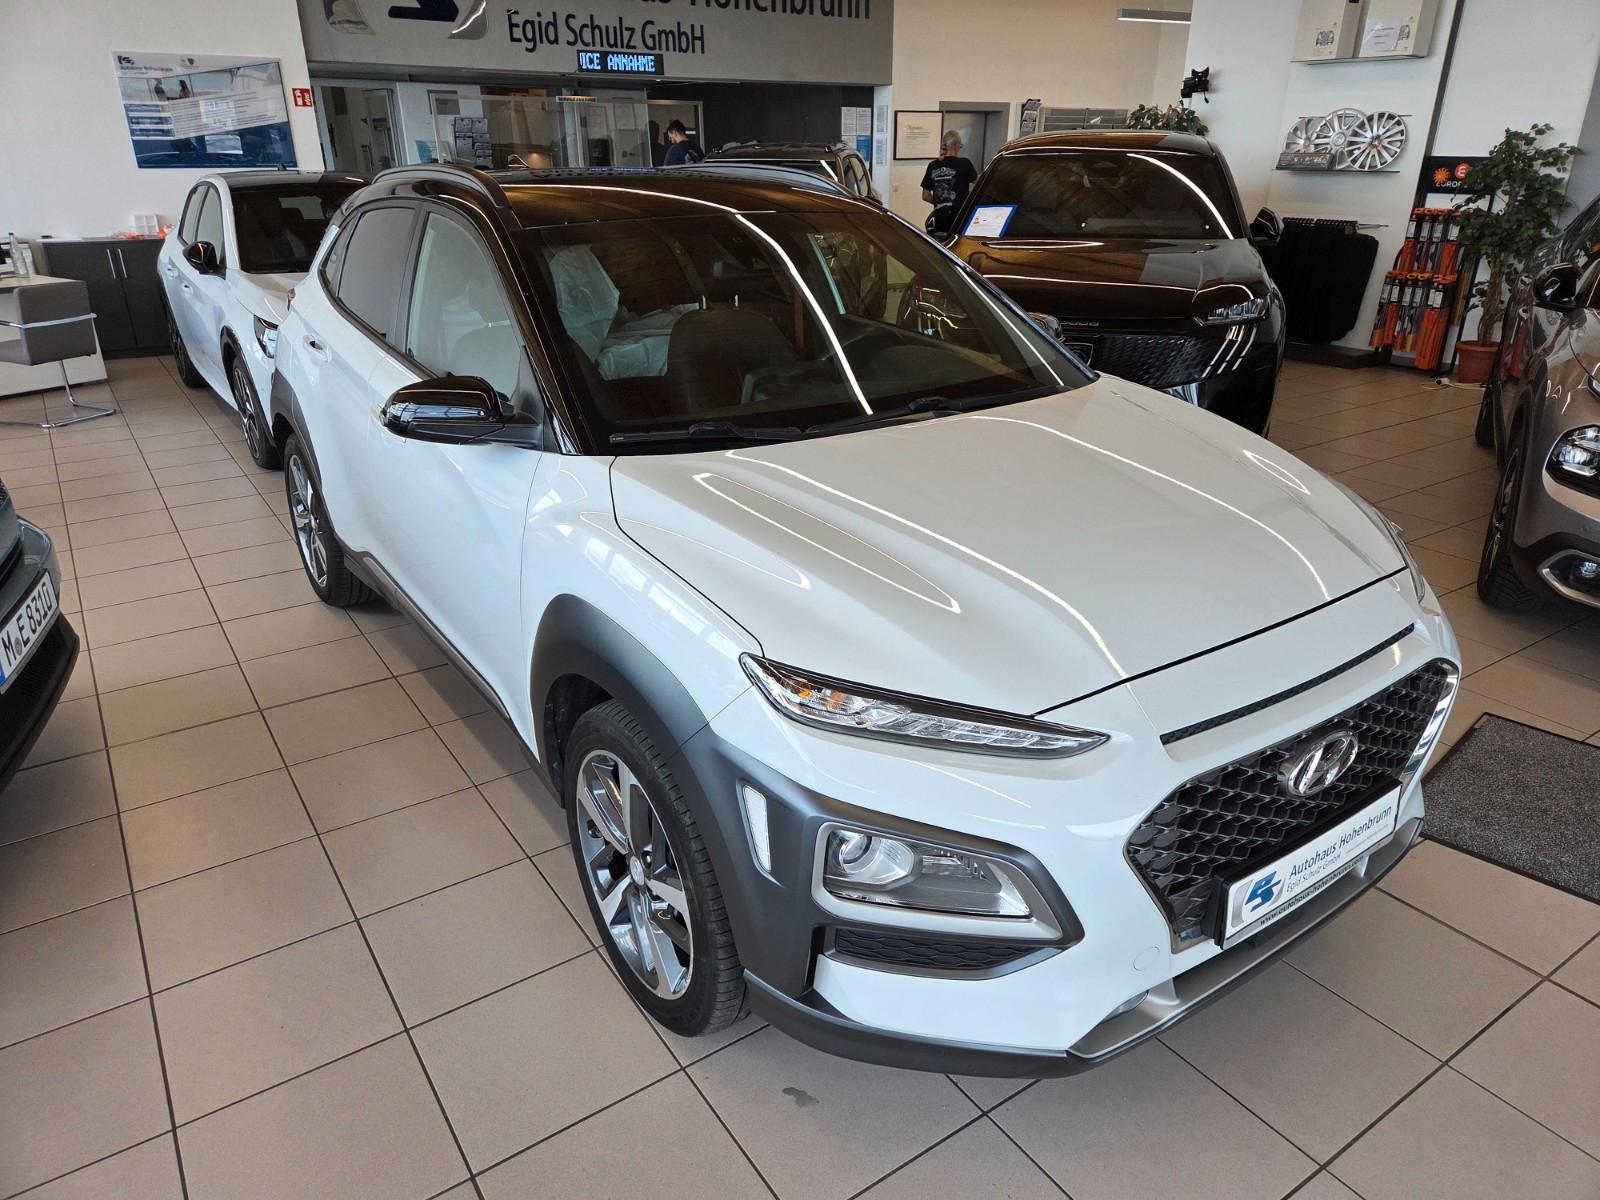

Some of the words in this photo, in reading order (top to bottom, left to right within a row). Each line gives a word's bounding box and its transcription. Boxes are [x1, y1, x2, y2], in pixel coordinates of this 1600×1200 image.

[507, 9, 559, 52] Egid
[564, 13, 637, 50] Schulz
[641, 20, 705, 54] GmbH
[579, 52, 601, 70] ICE
[607, 54, 655, 72] ANNAHME
[1, 630, 17, 667] M
[16, 613, 30, 648] E
[25, 582, 52, 635] 8310
[1289, 842, 1337, 879] Autohaus
[1339, 806, 1392, 849] Hohenbrunn
[1286, 878, 1302, 893] Egid
[1302, 865, 1323, 884] Schulz
[1322, 851, 1342, 870] GmbH
